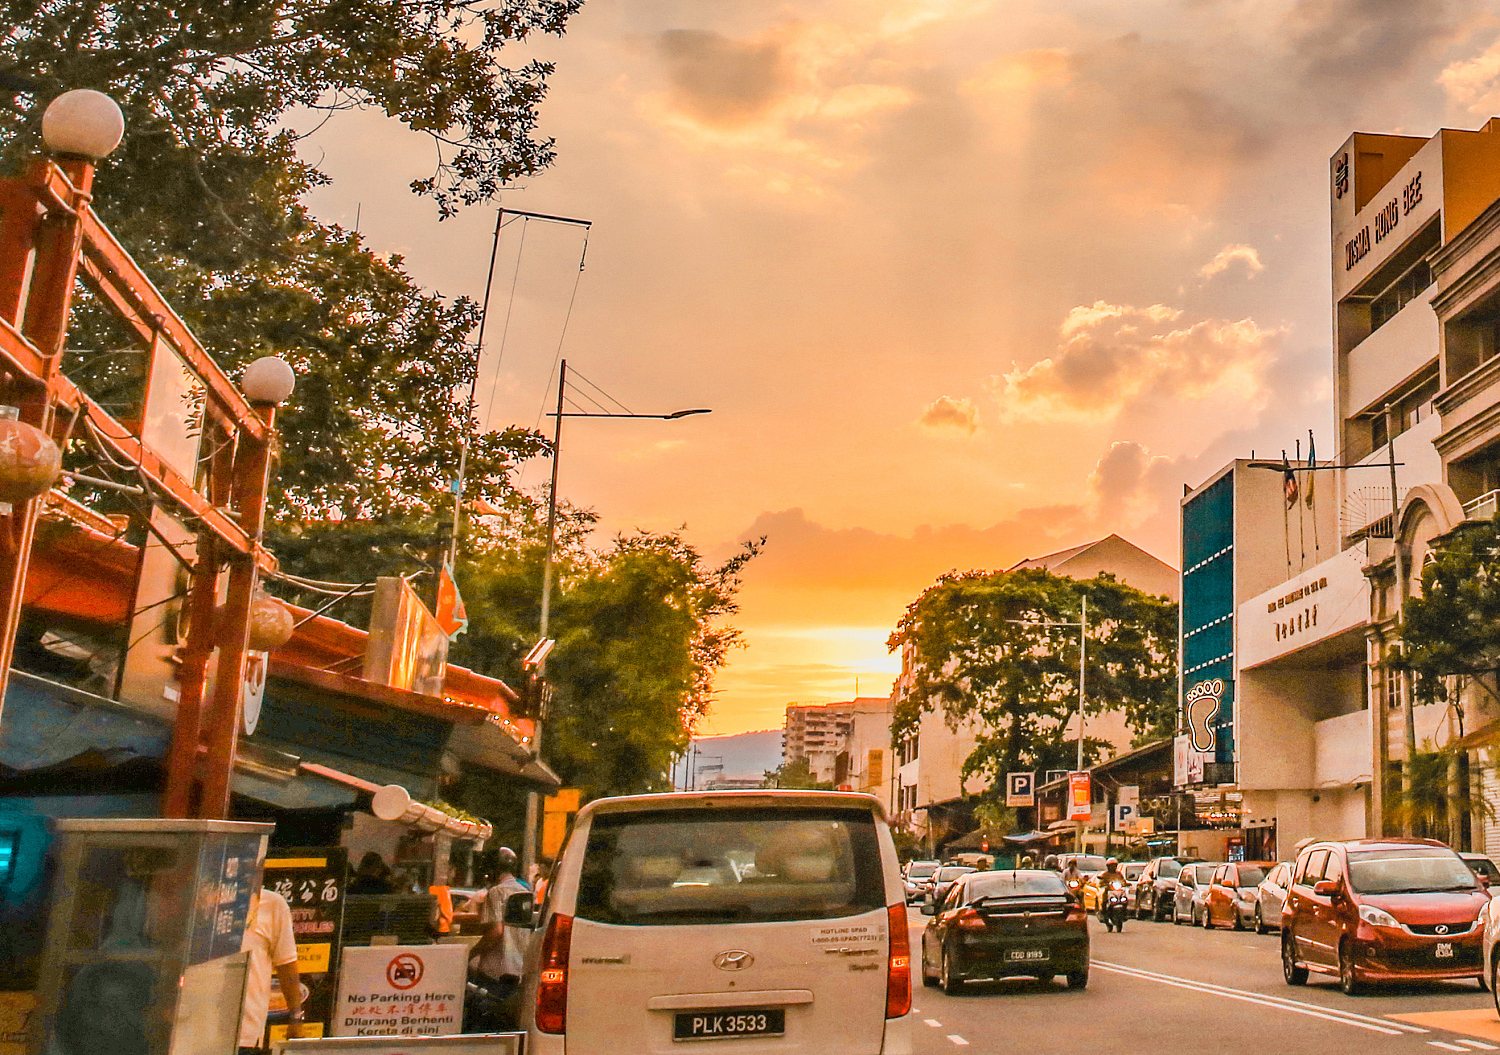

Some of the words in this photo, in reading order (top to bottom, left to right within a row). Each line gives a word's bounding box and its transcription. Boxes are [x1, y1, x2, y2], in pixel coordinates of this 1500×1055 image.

[1345, 225, 1371, 271] WISMA
[1375, 197, 1399, 244] HONG
[1403, 171, 1423, 216] BEE
[1014, 777, 1027, 793] P
[1120, 806, 1131, 820] P
[348, 994, 367, 1003] No
[370, 993, 421, 1004] Parking
[425, 992, 456, 1002] Here
[345, 1017, 397, 1027] Dilarang
[401, 1015, 454, 1025] Berhenti
[693, 1016, 723, 1034] PLK
[726, 1014, 767, 1032] 3533
[357, 1027, 398, 1036] Kereta
[401, 1026, 413, 1035] di
[417, 1026, 439, 1034] sini
